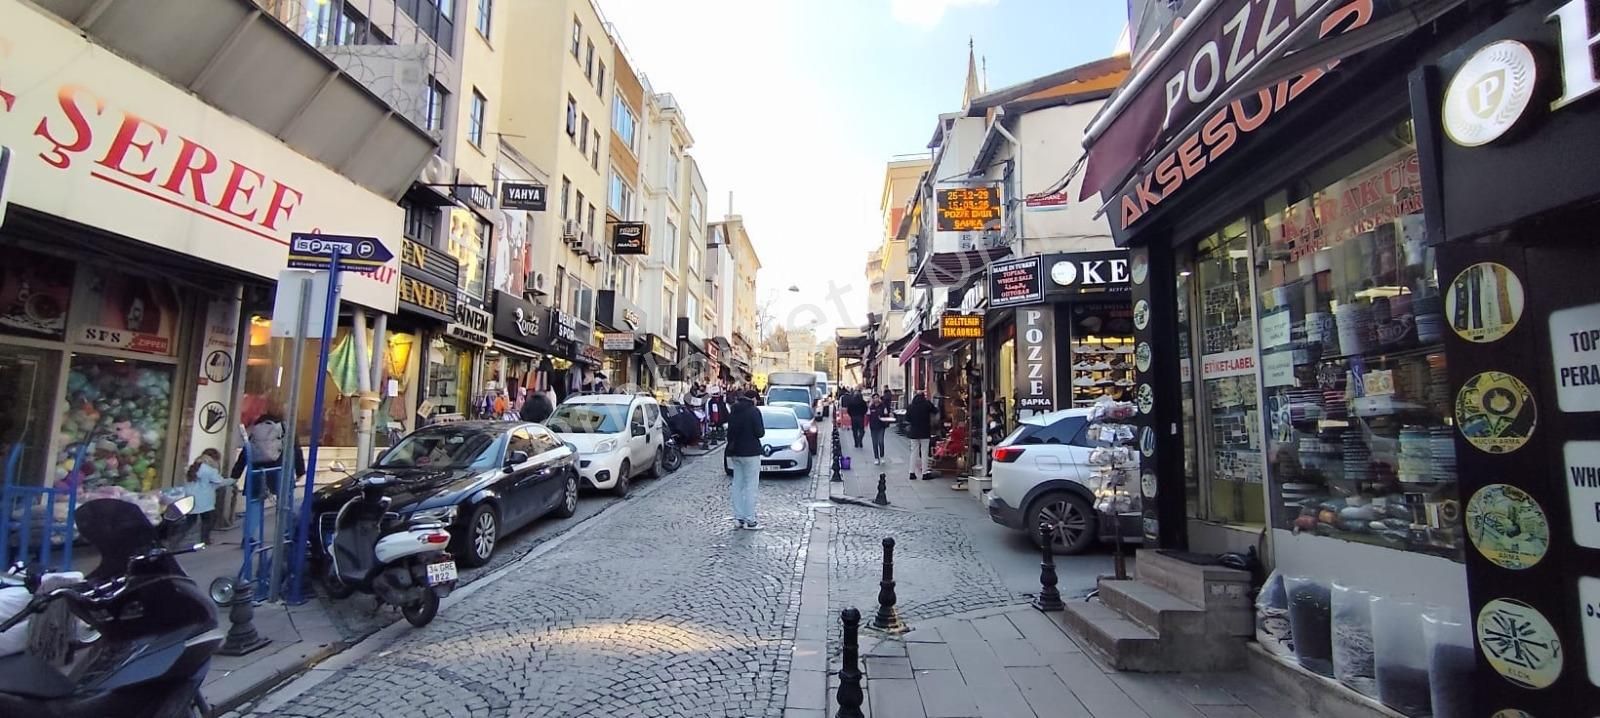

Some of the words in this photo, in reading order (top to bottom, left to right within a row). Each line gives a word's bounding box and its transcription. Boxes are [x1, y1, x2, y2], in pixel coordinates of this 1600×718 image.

[1163, 0, 1311, 130] POZZ
[33, 83, 303, 231] ŞEREF
[508, 187, 540, 200] YAHYA
[85, 327, 121, 343] SFS
[558, 324, 575, 342] SPOR
[1570, 329, 1600, 353] TOP
[1025, 310, 1044, 396] POZZE
[1021, 398, 1051, 406] ŞAPKA
[1498, 552, 1521, 562] ARMA
